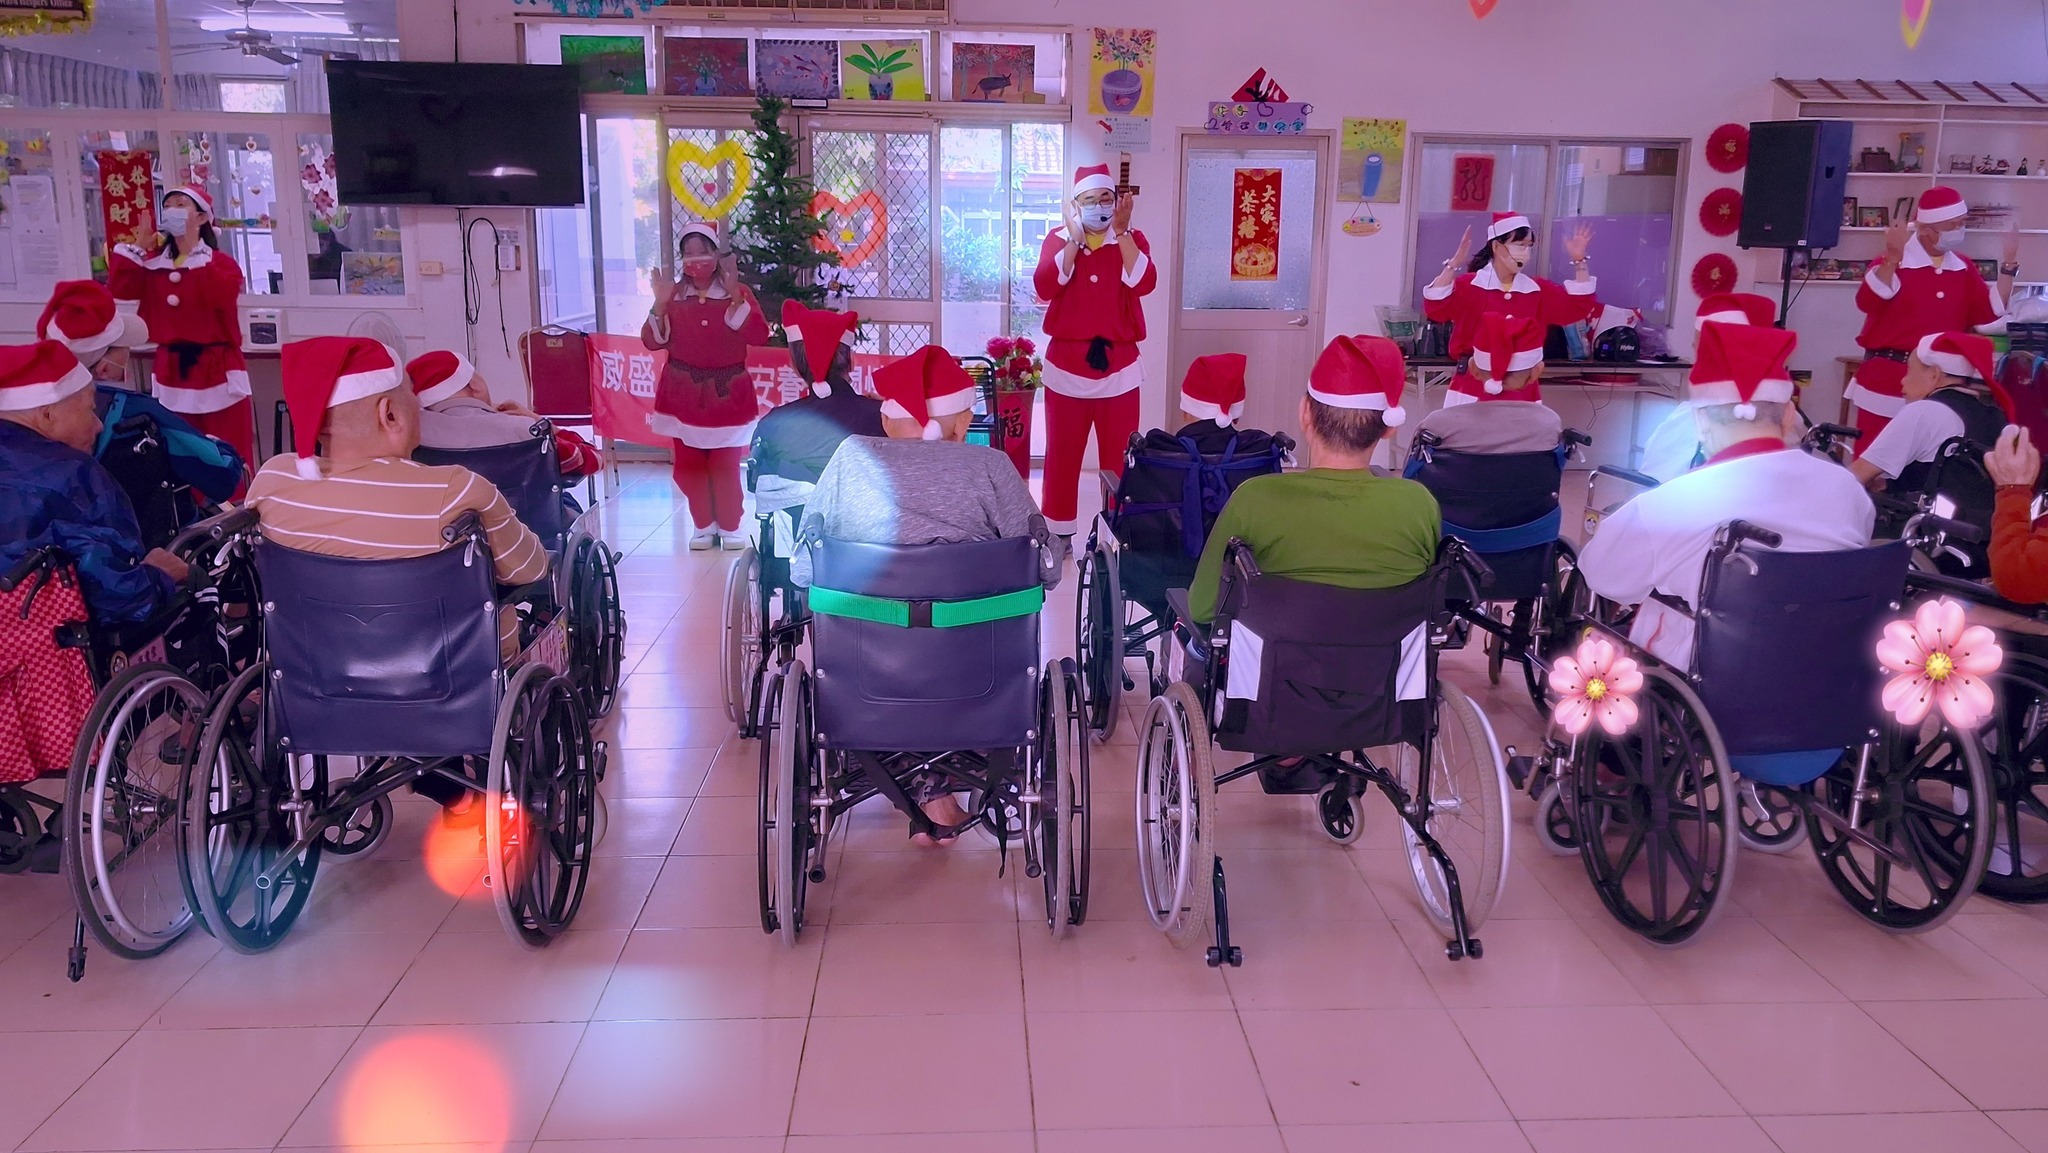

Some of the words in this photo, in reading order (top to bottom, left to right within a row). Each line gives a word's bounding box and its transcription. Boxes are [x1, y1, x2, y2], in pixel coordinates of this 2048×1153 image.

[104, 172, 132, 226] 發財
[128, 165, 151, 209] 恭喜
[1260, 184, 1277, 225] 大家
[1001, 407, 1025, 439] 福
